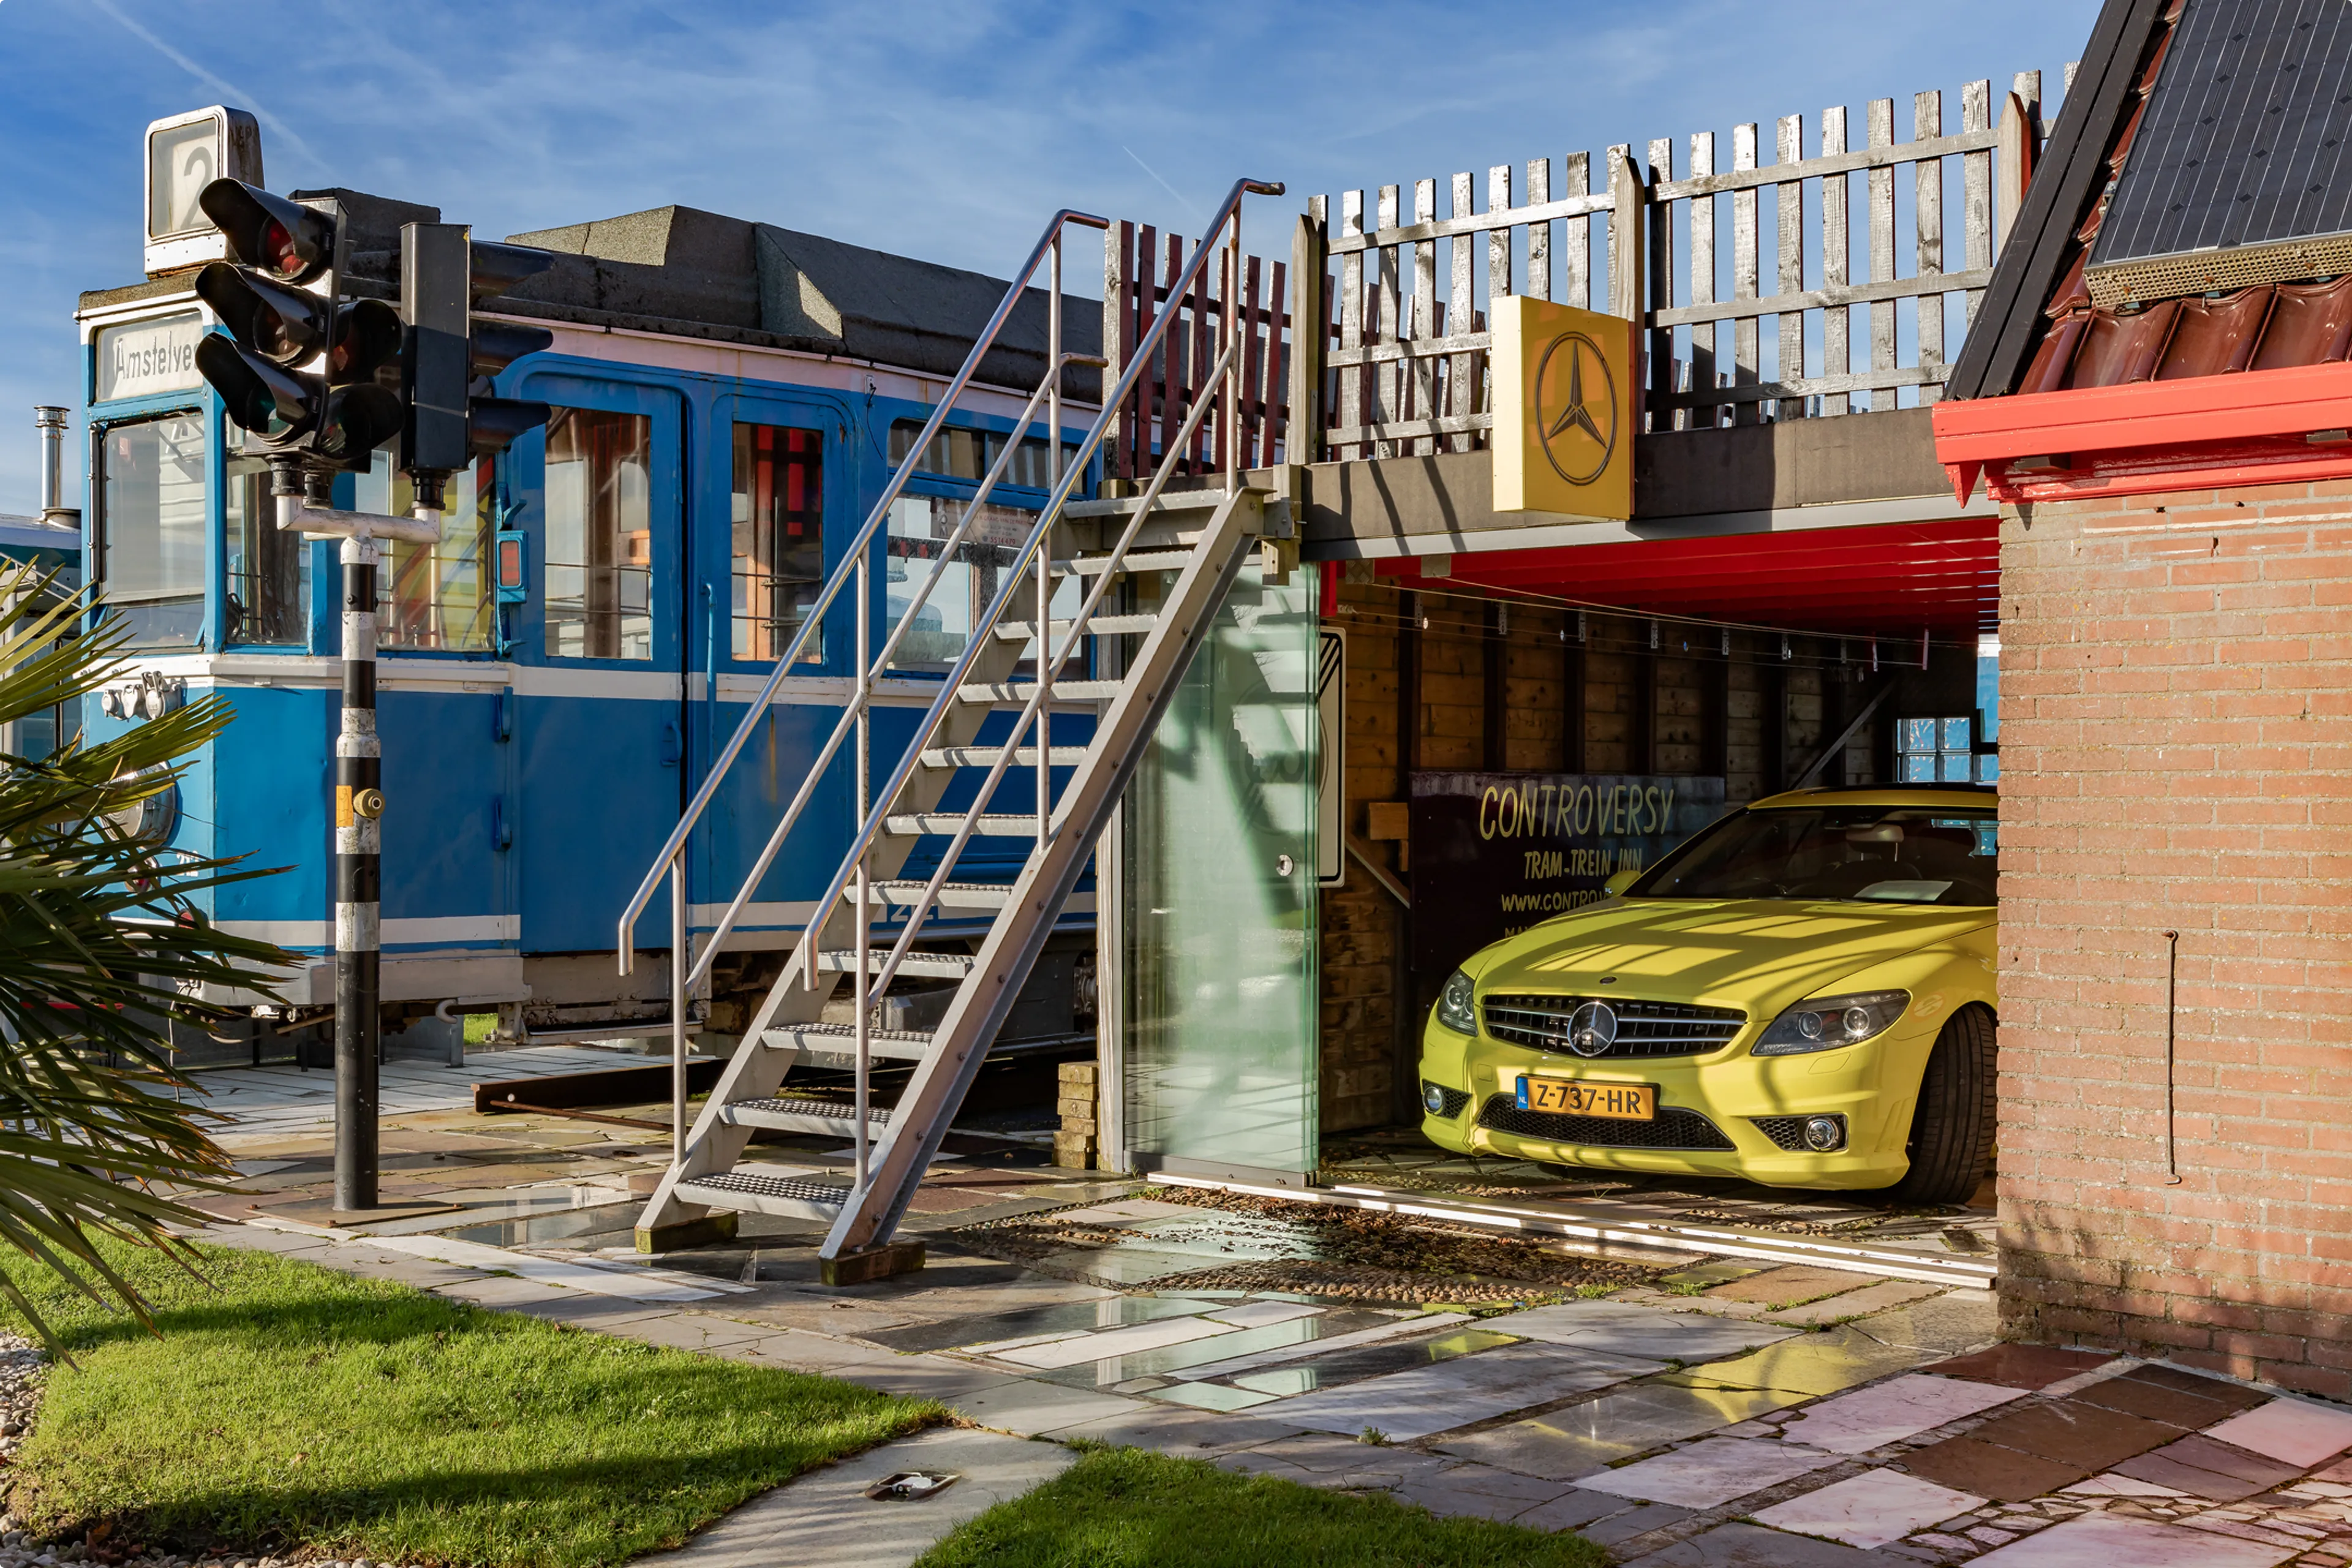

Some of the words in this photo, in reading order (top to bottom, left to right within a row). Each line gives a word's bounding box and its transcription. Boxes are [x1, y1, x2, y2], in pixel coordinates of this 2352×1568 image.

[179, 146, 213, 231] 2
[115, 330, 198, 380] Amstelve
[1479, 783, 1674, 840] CONTROVERSY
[1618, 847, 1642, 875] INN
[1518, 1096, 1527, 1104] NL
[1536, 1084, 1641, 1114] Z-737-HR
